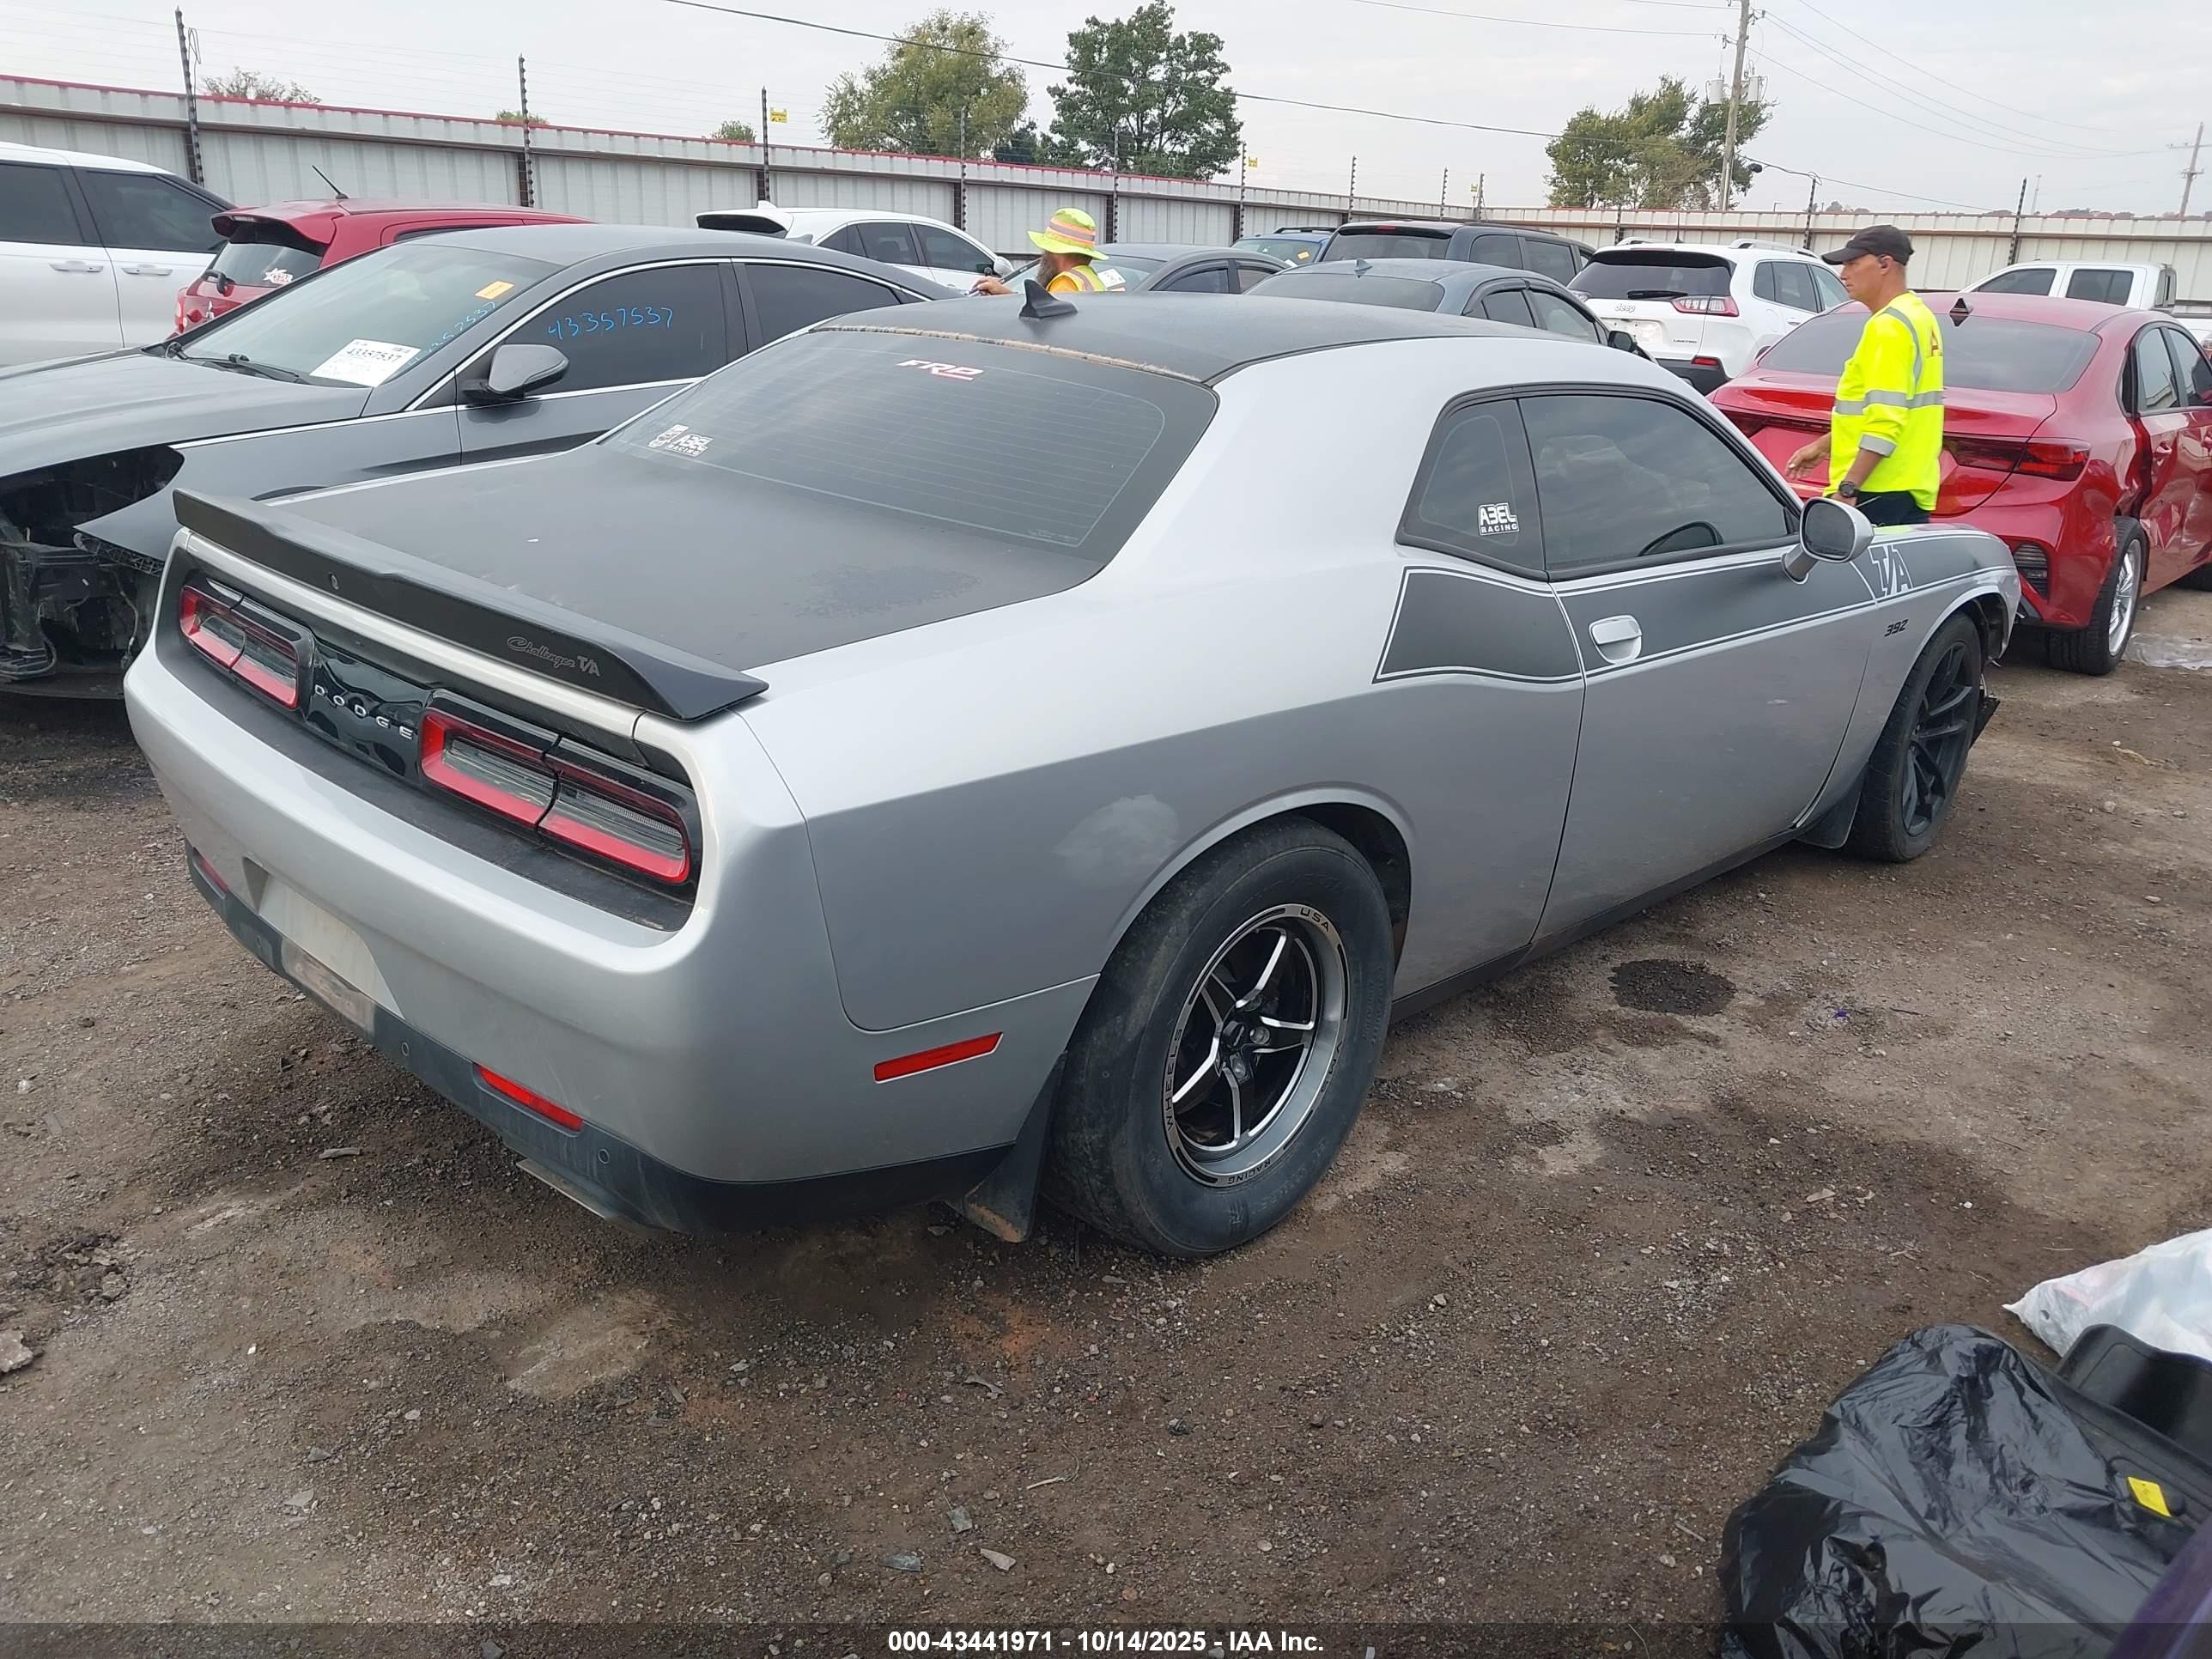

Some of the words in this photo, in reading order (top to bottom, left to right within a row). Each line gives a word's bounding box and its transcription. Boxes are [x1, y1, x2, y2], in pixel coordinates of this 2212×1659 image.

[1614, 303, 1636, 313] Jeep
[548, 306, 673, 340] 43357537
[346, 347, 403, 362] 43357537
[1480, 523, 1517, 533] RACING
[1884, 618, 1909, 637] 392
[507, 636, 576, 668] Challenger
[314, 684, 414, 740] DODGE
[1300, 907, 1329, 933] USA
[1165, 1028, 1183, 1131] WHEELS
[1228, 1158, 1271, 1185] RACING
